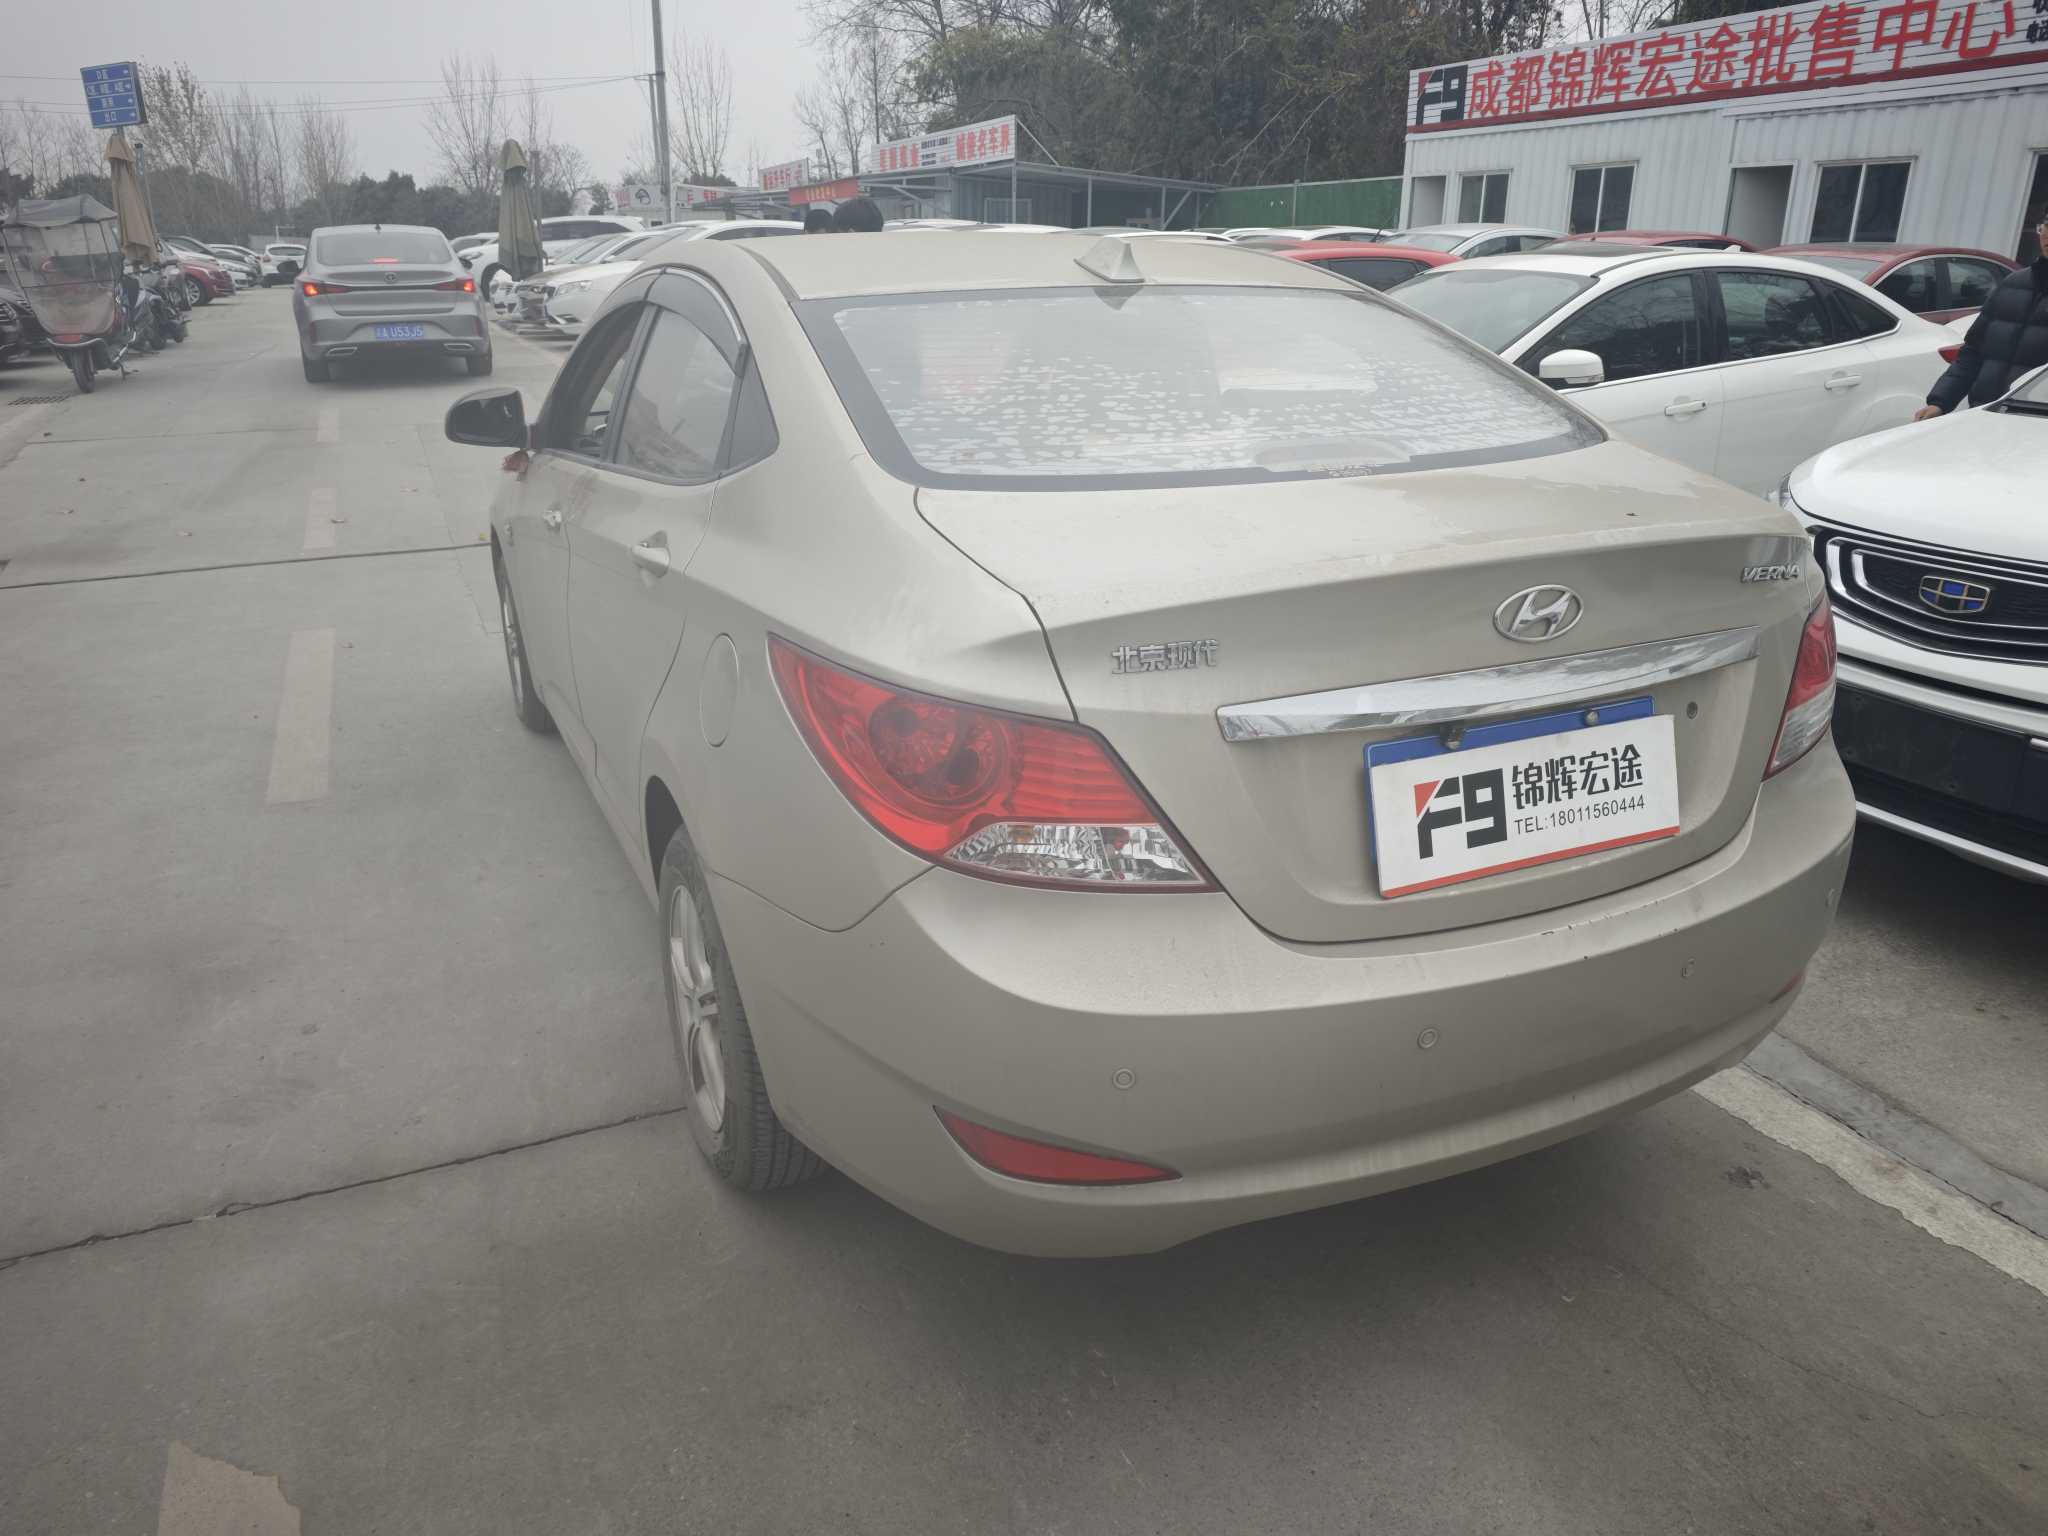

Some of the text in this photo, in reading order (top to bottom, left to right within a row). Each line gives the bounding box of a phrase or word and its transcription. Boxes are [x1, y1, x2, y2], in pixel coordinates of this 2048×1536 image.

[1468, 0, 2015, 119] 成都锦辉宏途批售中心
[1742, 564, 1800, 582] VERNA
[1111, 640, 1217, 674] 北京现代
[1511, 743, 1645, 809] 锦辉宏途
[1414, 768, 1507, 860] F9
[1514, 794, 1645, 834] TEL:18011560444
